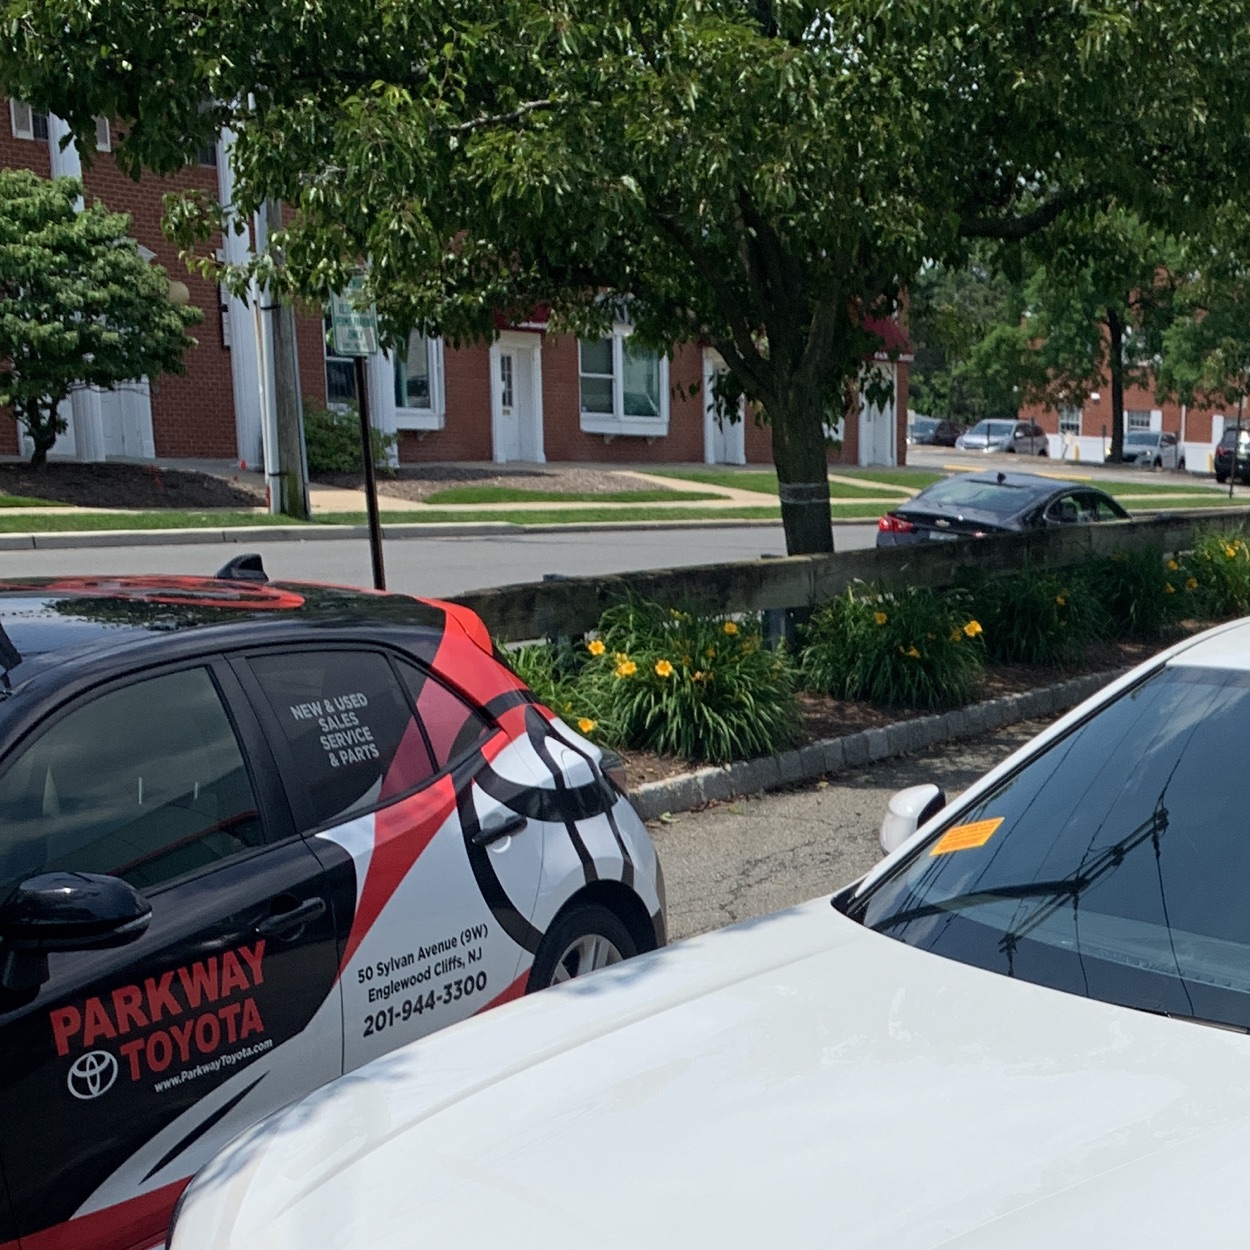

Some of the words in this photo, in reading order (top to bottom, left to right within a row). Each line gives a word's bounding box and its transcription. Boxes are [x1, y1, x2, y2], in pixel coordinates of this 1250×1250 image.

[290, 701, 323, 720] NEW
[323, 699, 335, 713] &
[333, 692, 368, 711] USED
[318, 711, 359, 732] SALES
[320, 726, 374, 751] SERVICE
[328, 752, 340, 767] &
[339, 743, 380, 765] PARTS
[357, 966, 373, 984] 50
[376, 952, 415, 977] Sylvan
[417, 936, 457, 961] Avenue
[460, 923, 488, 946] (9W)
[368, 966, 431, 1003] Englewood
[434, 954, 465, 977] Cliffs,
[467, 946, 482, 964] NJ
[50, 939, 266, 1057] PARKWAY
[363, 970, 487, 1038] 201-944-3300
[119, 997, 265, 1082] TOYOTA
[153, 1038, 273, 1093] www.ParkwayToyota.com
